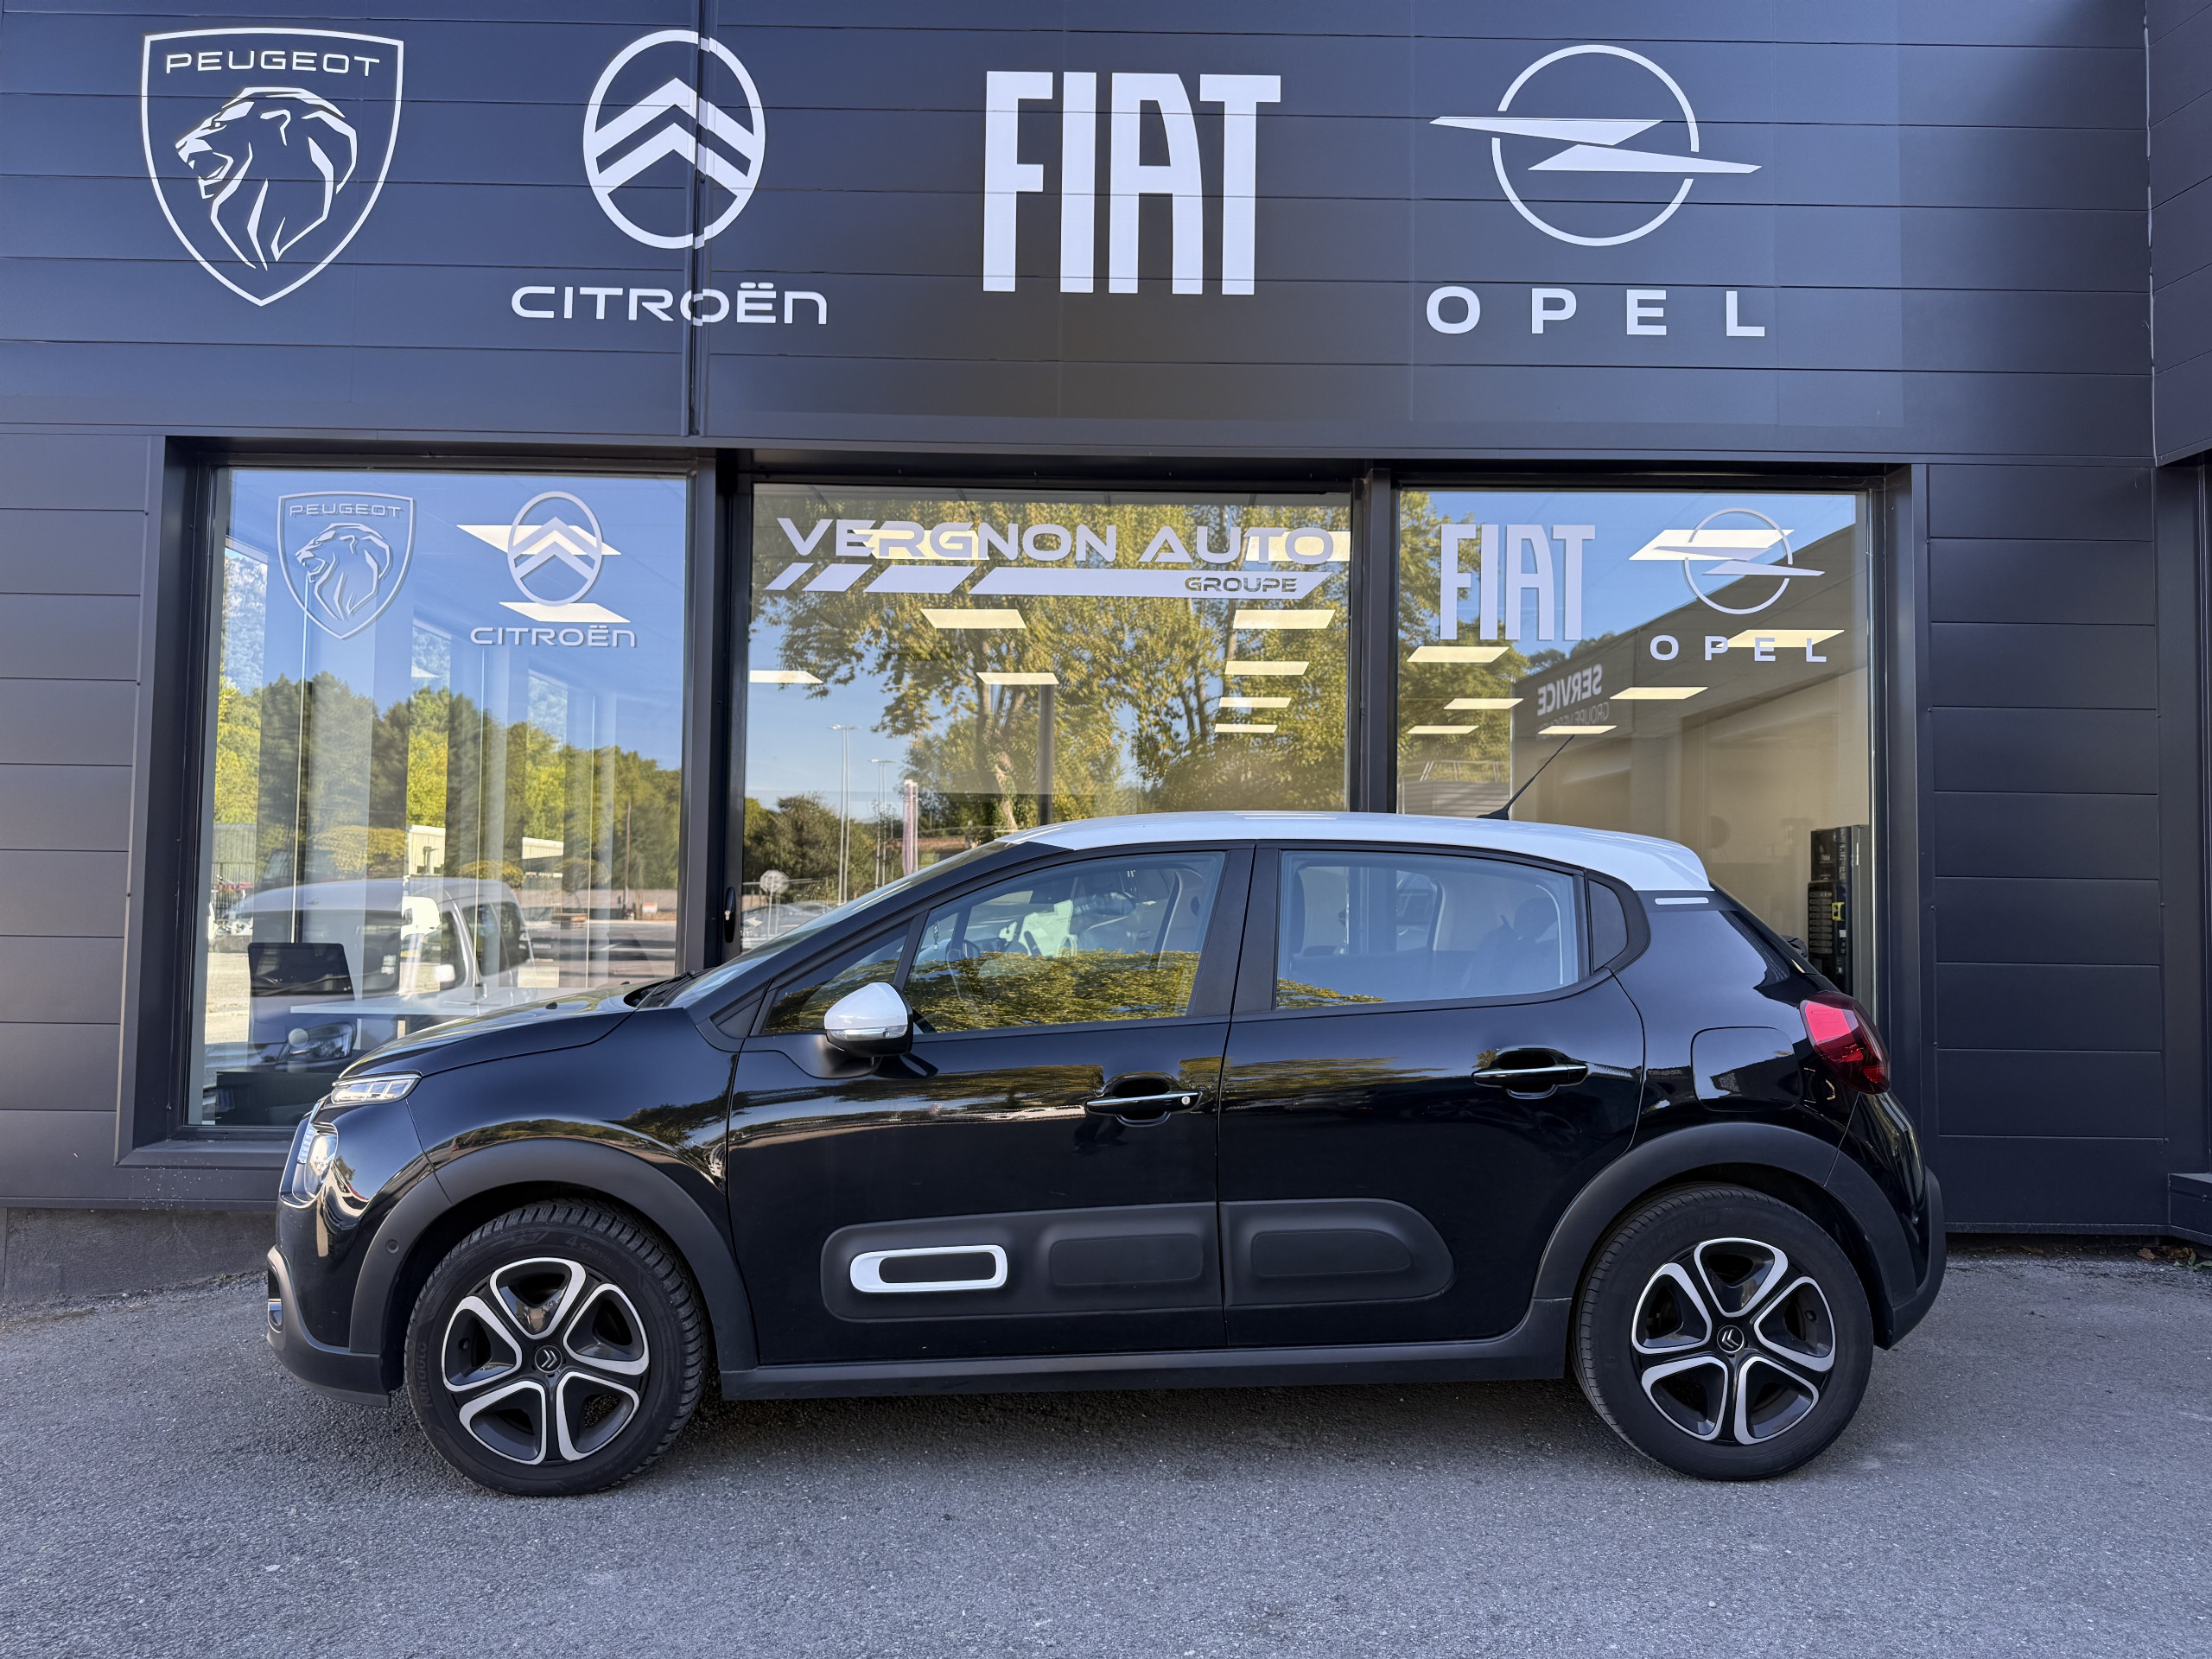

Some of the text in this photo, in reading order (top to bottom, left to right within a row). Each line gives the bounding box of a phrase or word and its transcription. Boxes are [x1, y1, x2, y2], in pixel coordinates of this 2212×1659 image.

[166, 50, 380, 77] PEUGEOT
[982, 71, 1281, 296] FIAT
[1426, 285, 1765, 337] OPEL
[289, 502, 402, 518] PEUGEOT
[777, 518, 1334, 564] VERGNON AUTO
[1185, 576, 1297, 593] GROUPE
[1440, 524, 1595, 640] FIAT
[1649, 634, 1827, 663] OPEL
